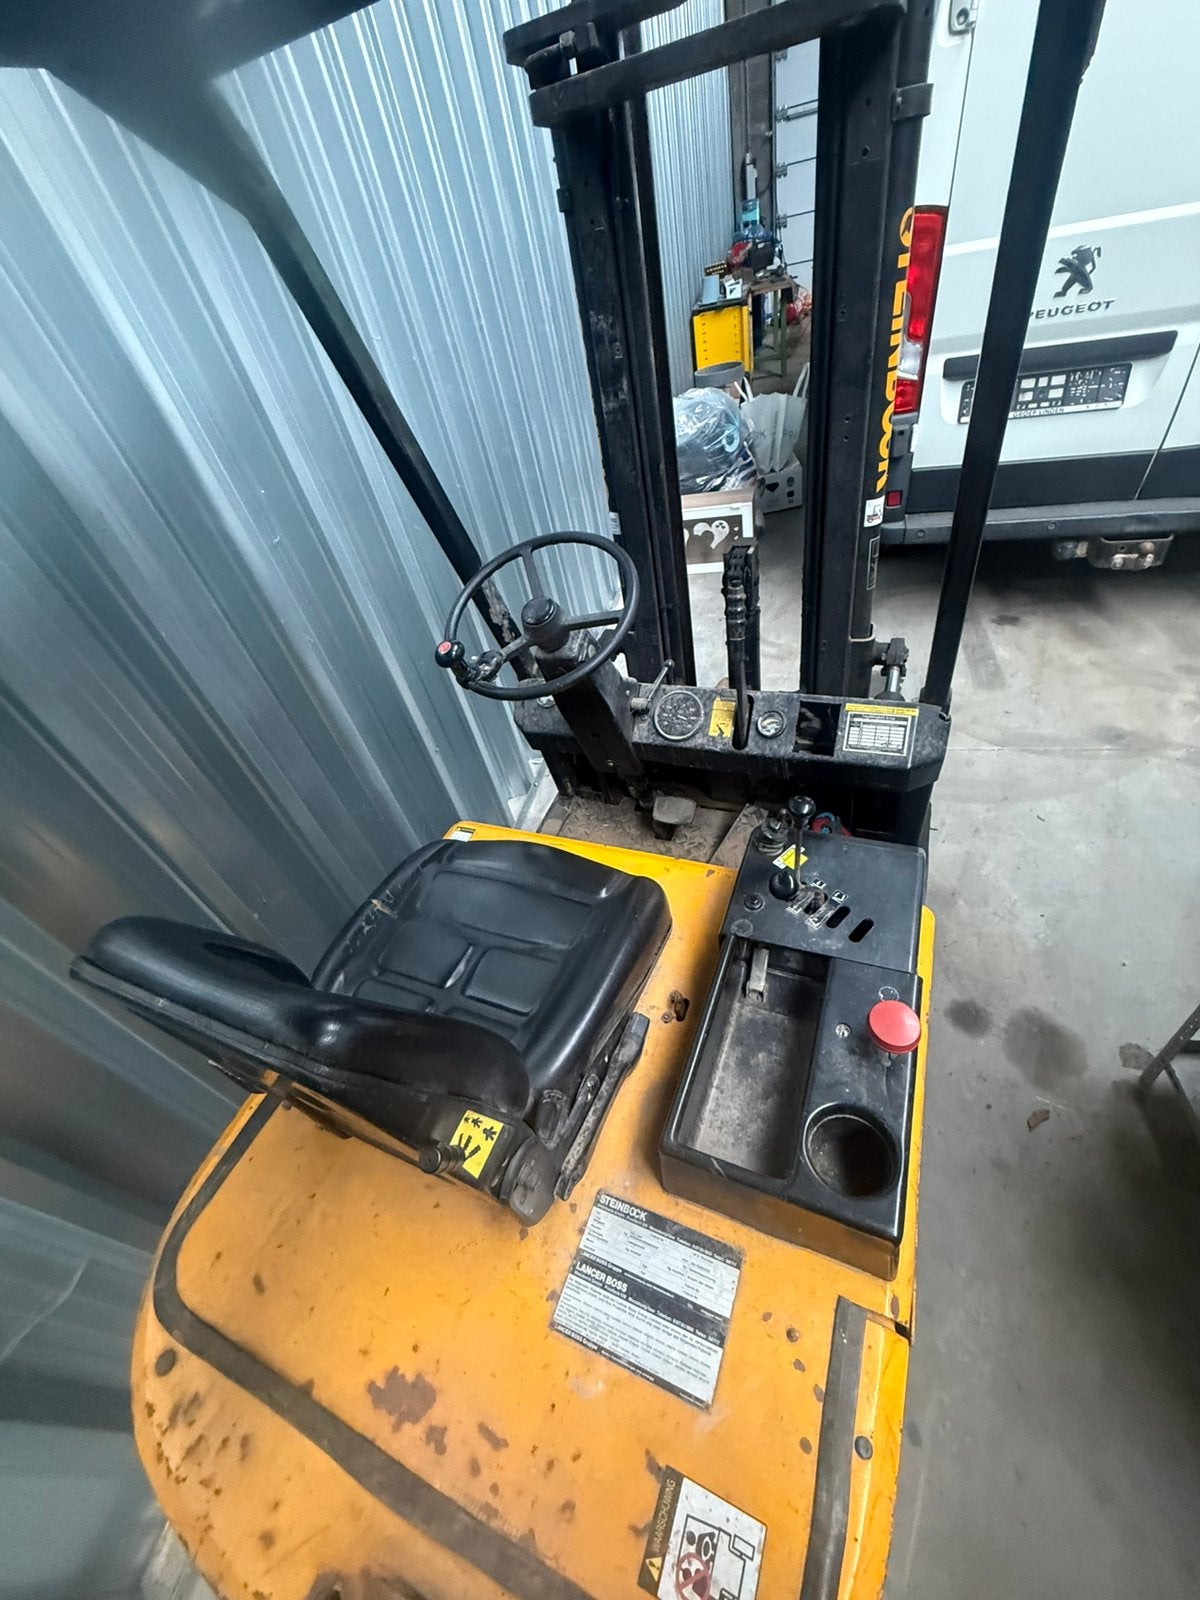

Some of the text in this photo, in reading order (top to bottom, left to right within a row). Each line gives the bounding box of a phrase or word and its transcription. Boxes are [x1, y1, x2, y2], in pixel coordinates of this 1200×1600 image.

[599, 1194, 648, 1222] STEINBOCK
[575, 1261, 606, 1283] LANCER
[605, 1275, 628, 1292] BOSS
